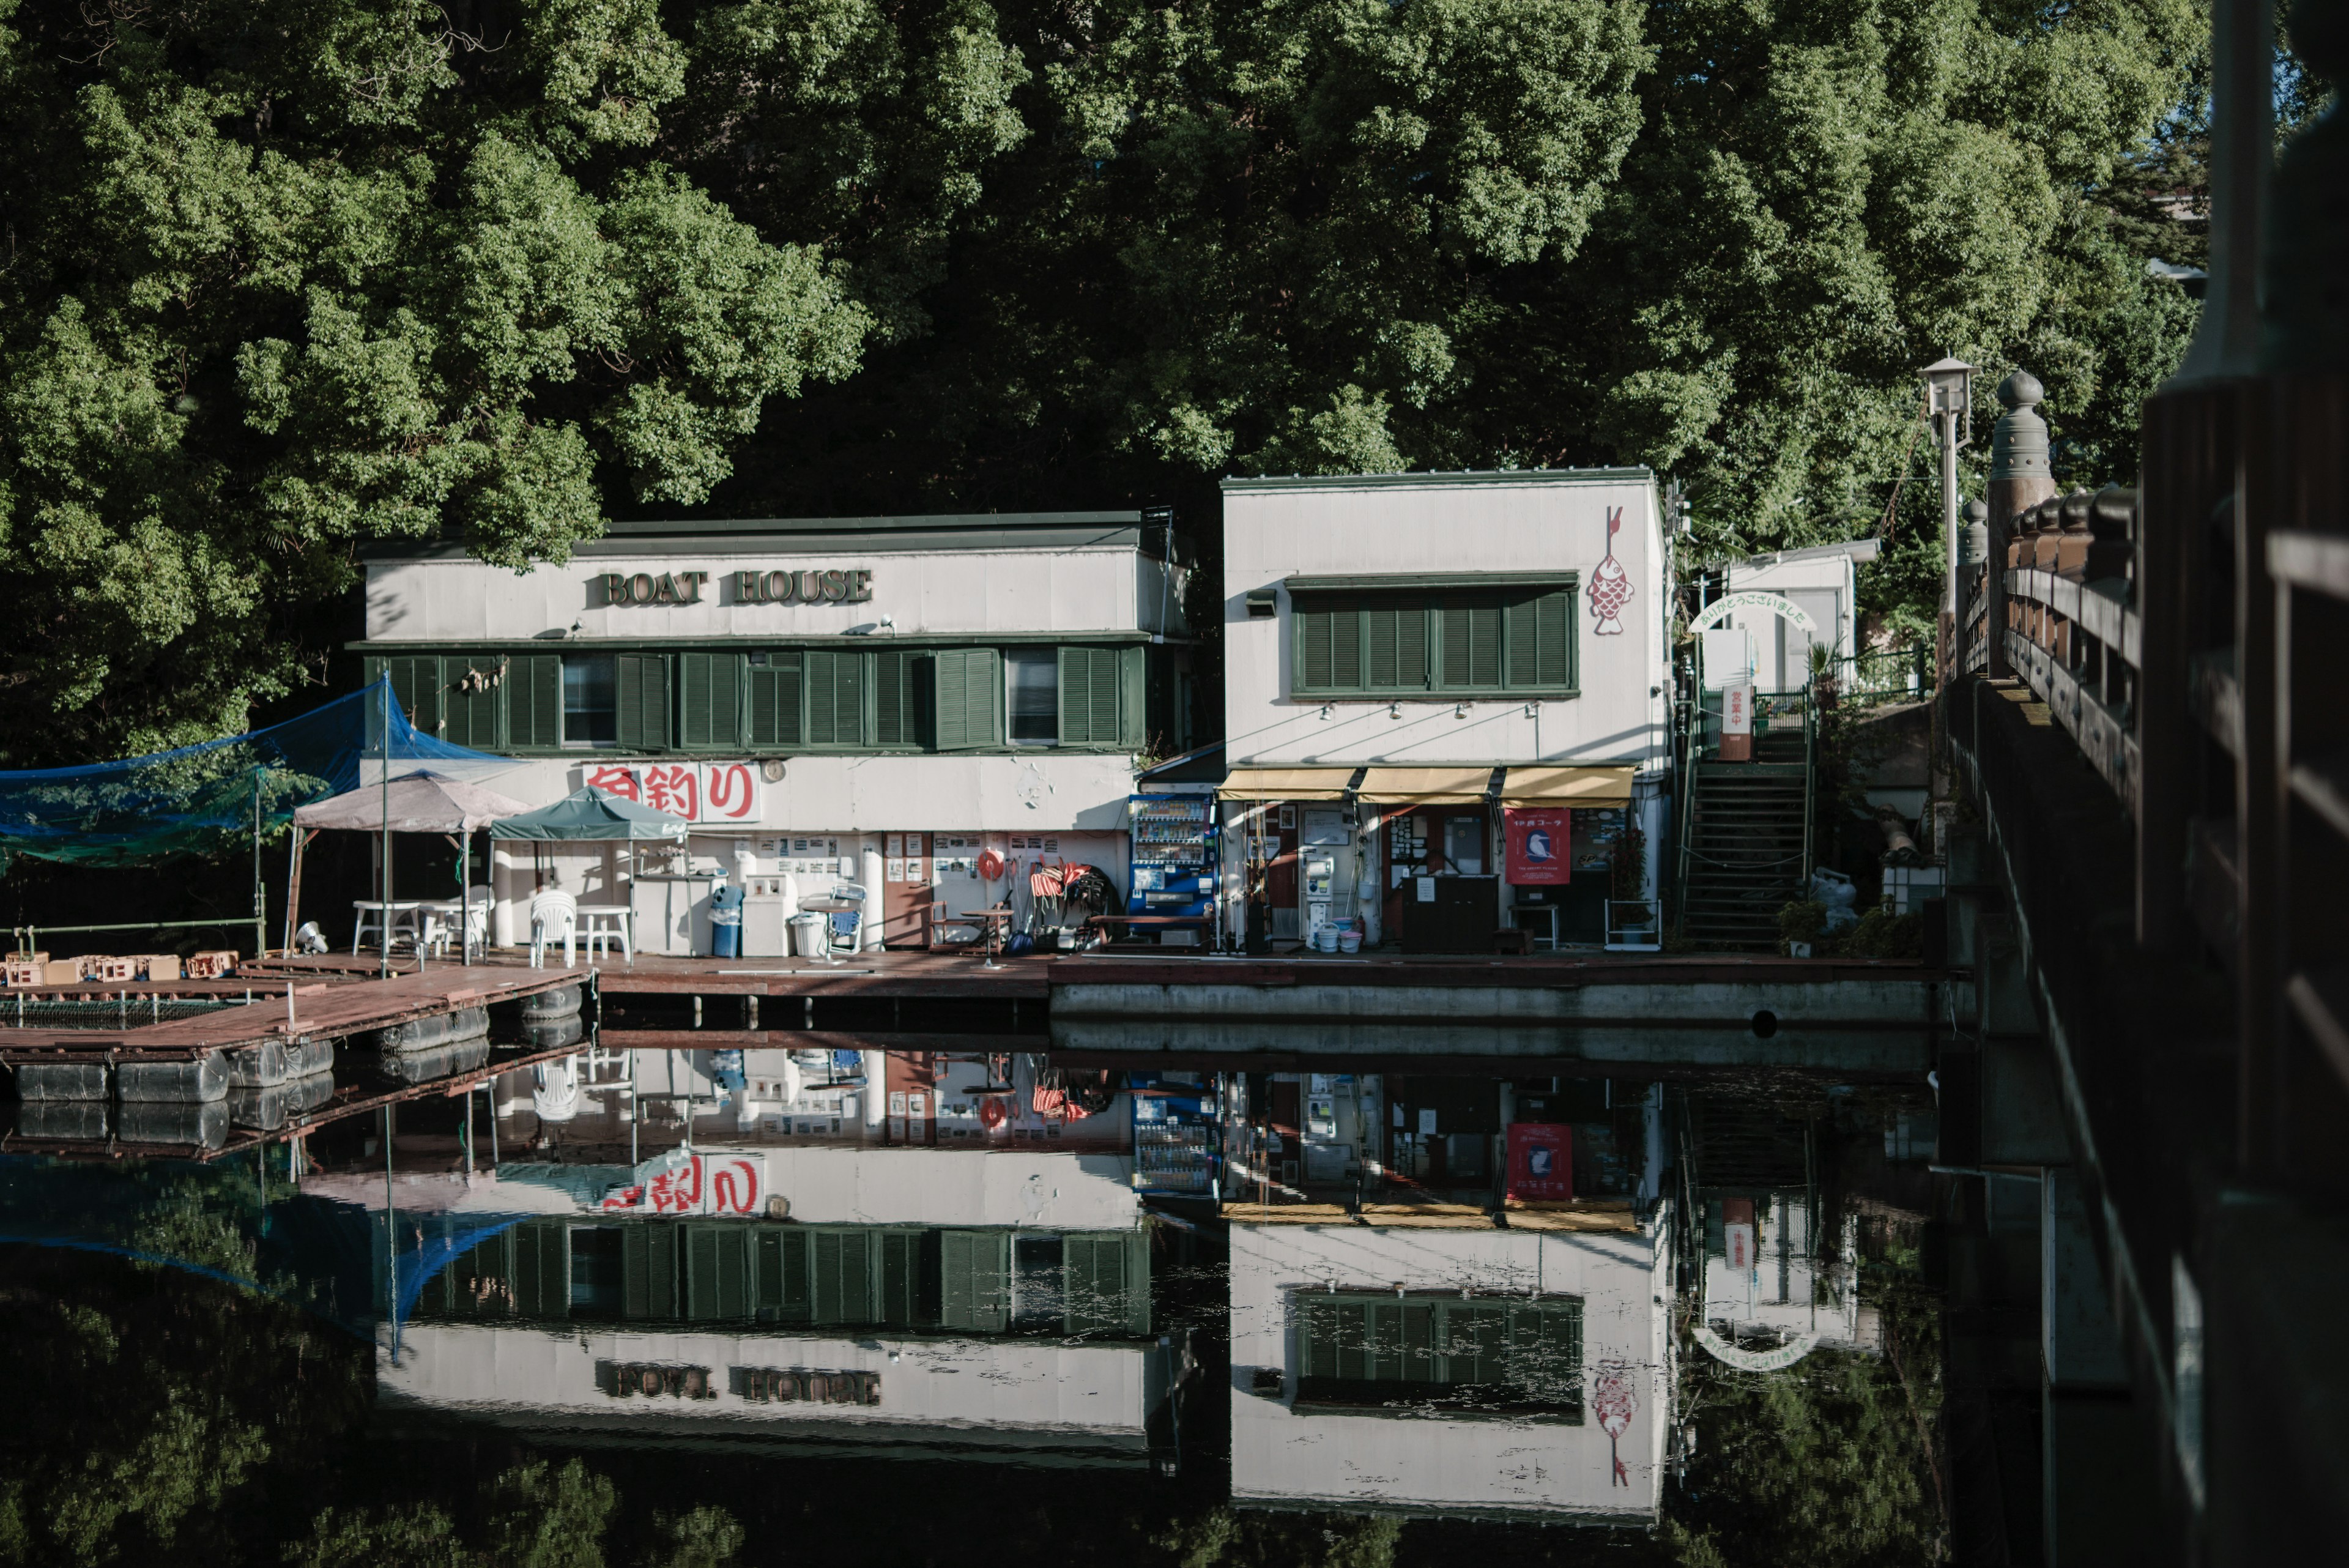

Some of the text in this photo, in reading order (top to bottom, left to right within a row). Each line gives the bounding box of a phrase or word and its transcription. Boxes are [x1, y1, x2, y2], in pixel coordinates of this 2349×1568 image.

[599, 570, 874, 604] BOAT HOUSE
[1700, 595, 1806, 626] ありがとうございました
[1731, 691, 1742, 726] 営業中
